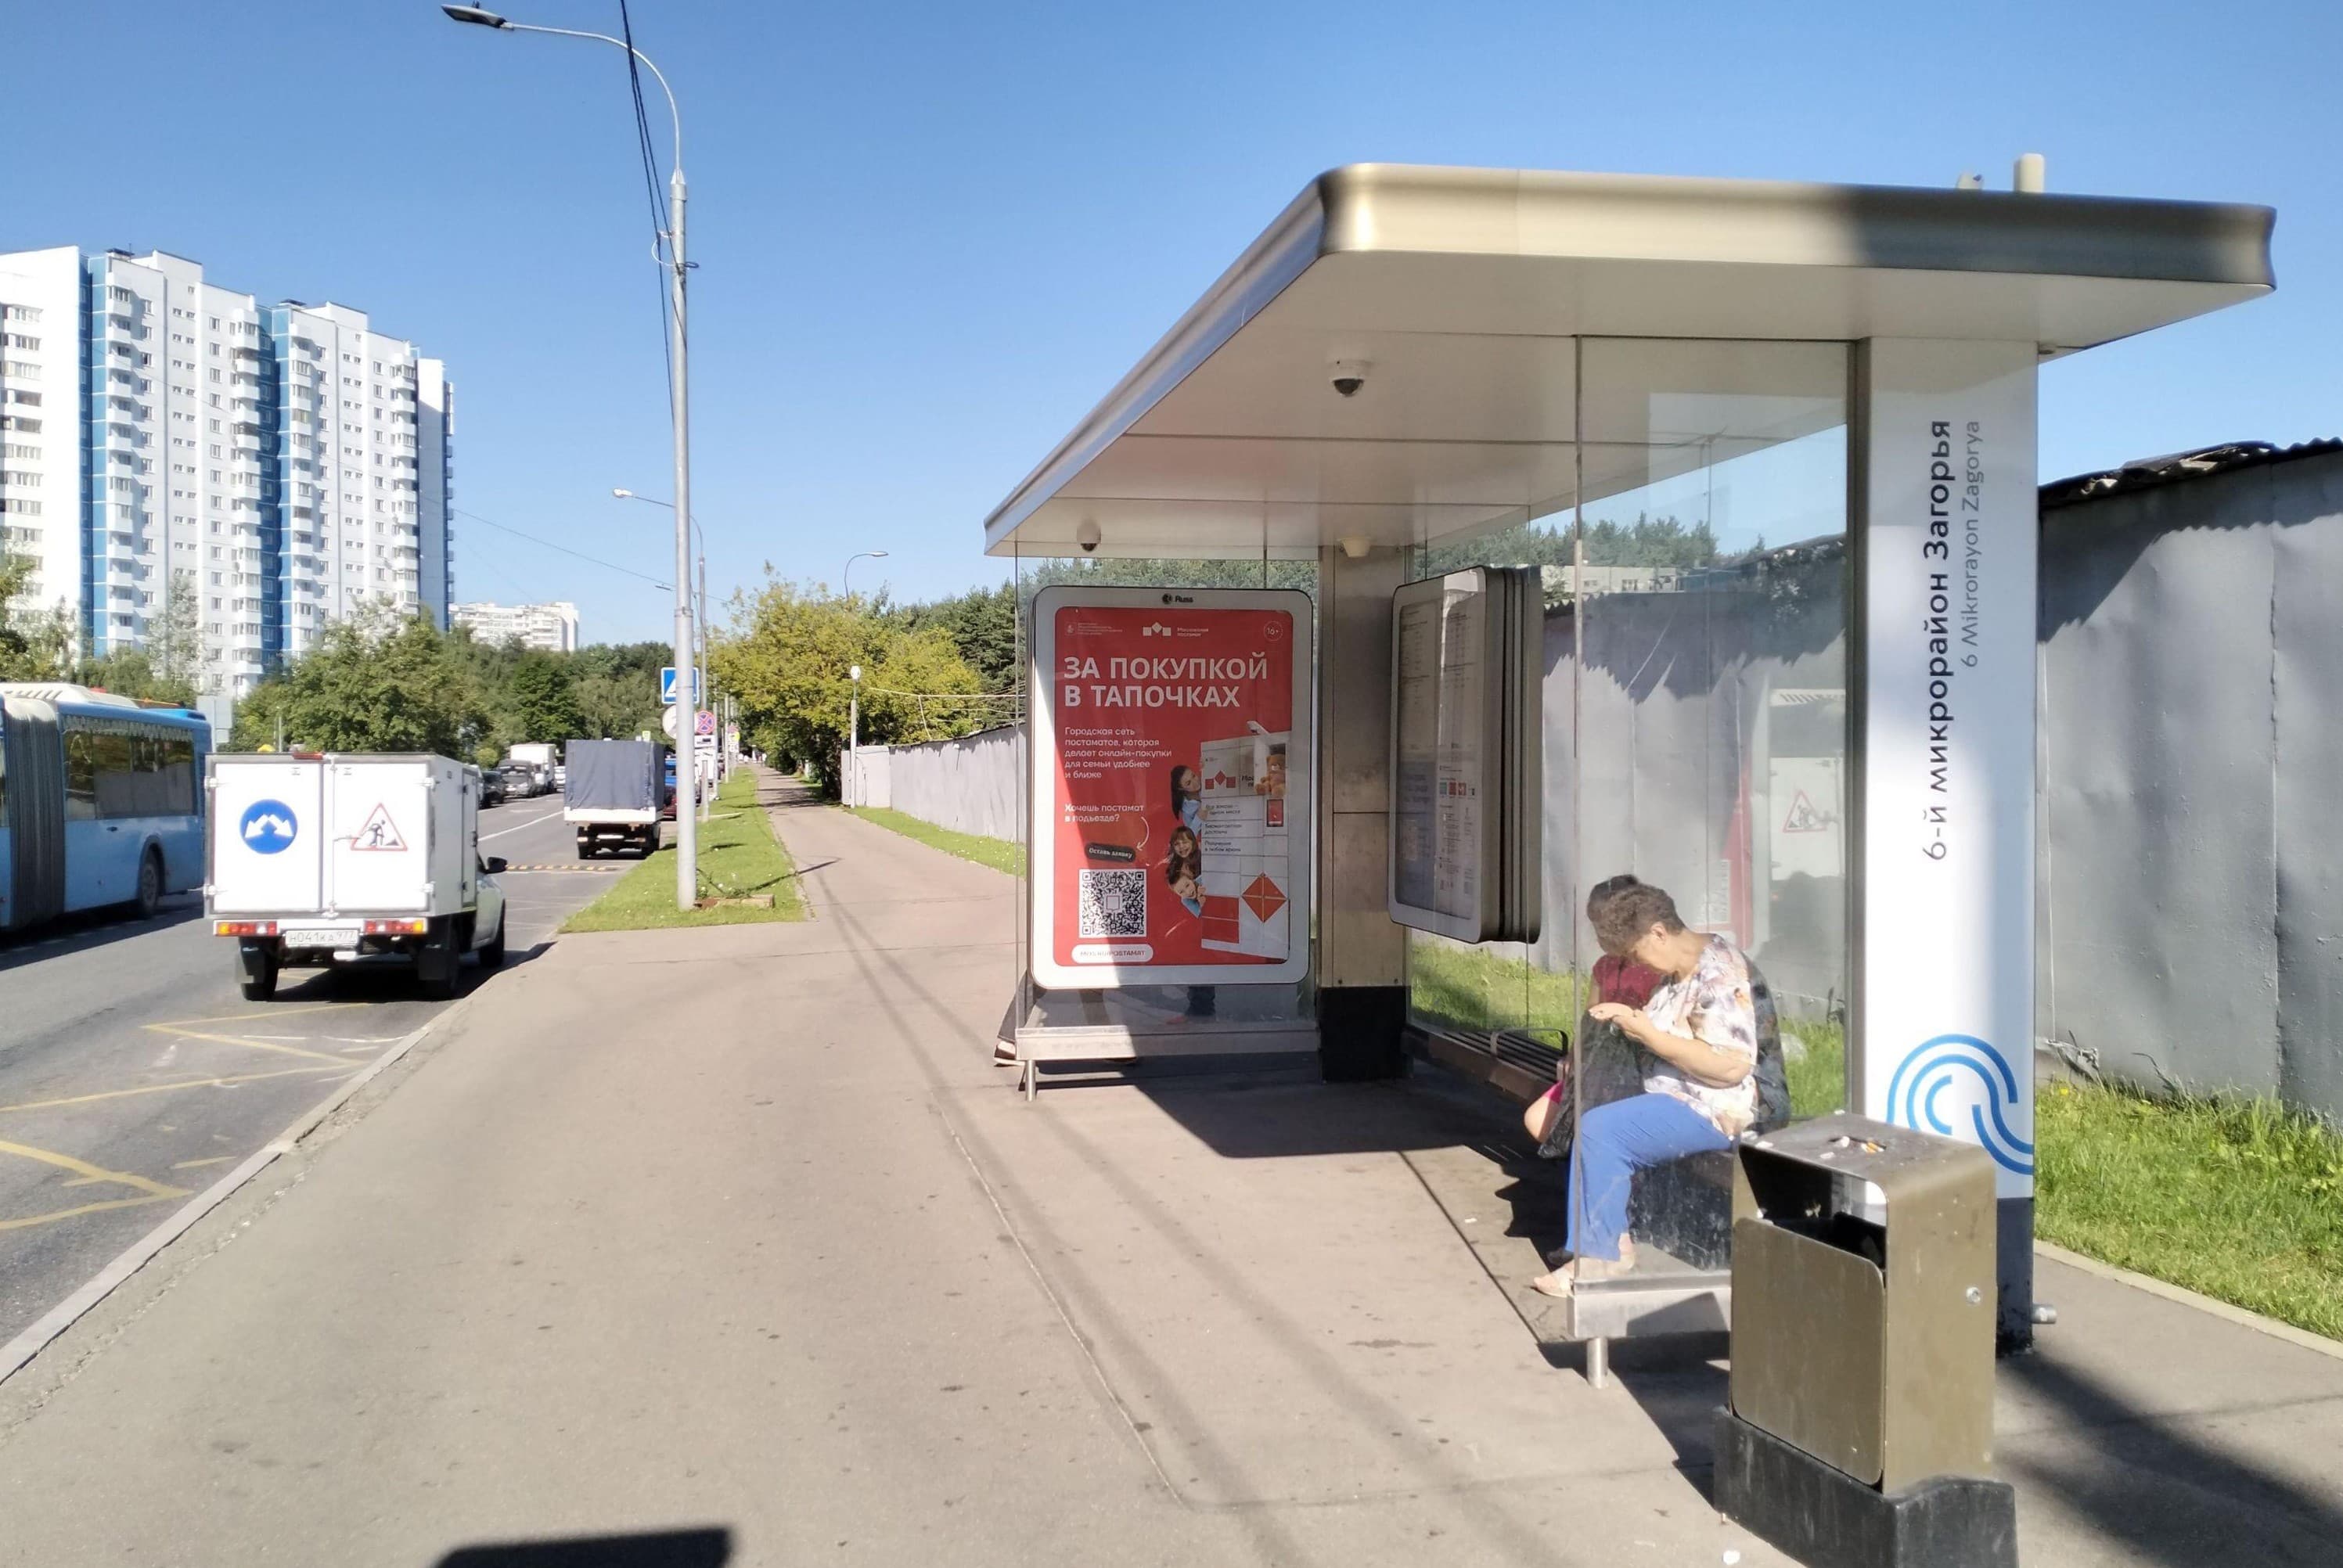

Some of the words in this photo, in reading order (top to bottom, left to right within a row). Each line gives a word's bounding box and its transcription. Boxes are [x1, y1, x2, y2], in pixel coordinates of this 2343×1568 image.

[1961, 420, 1985, 512] Zagorya
[1923, 419, 1956, 560] Загорья
[1960, 518, 1982, 647] Mikrorayon
[1064, 656, 1100, 679] ЗА
[1110, 652, 1268, 679] ПОКУПКОЙ
[1960, 655, 1979, 668] 6
[1923, 574, 1955, 793] микрорайон
[1065, 686, 1081, 707] В
[1091, 685, 1240, 707] ТАПОЧКАХ
[1065, 727, 1113, 736] Городская
[1099, 749, 1172, 758] онлайн-покупки
[1113, 760, 1150, 768] удобнее
[1073, 770, 1102, 779] ближе
[1922, 804, 1948, 861] 6-й
